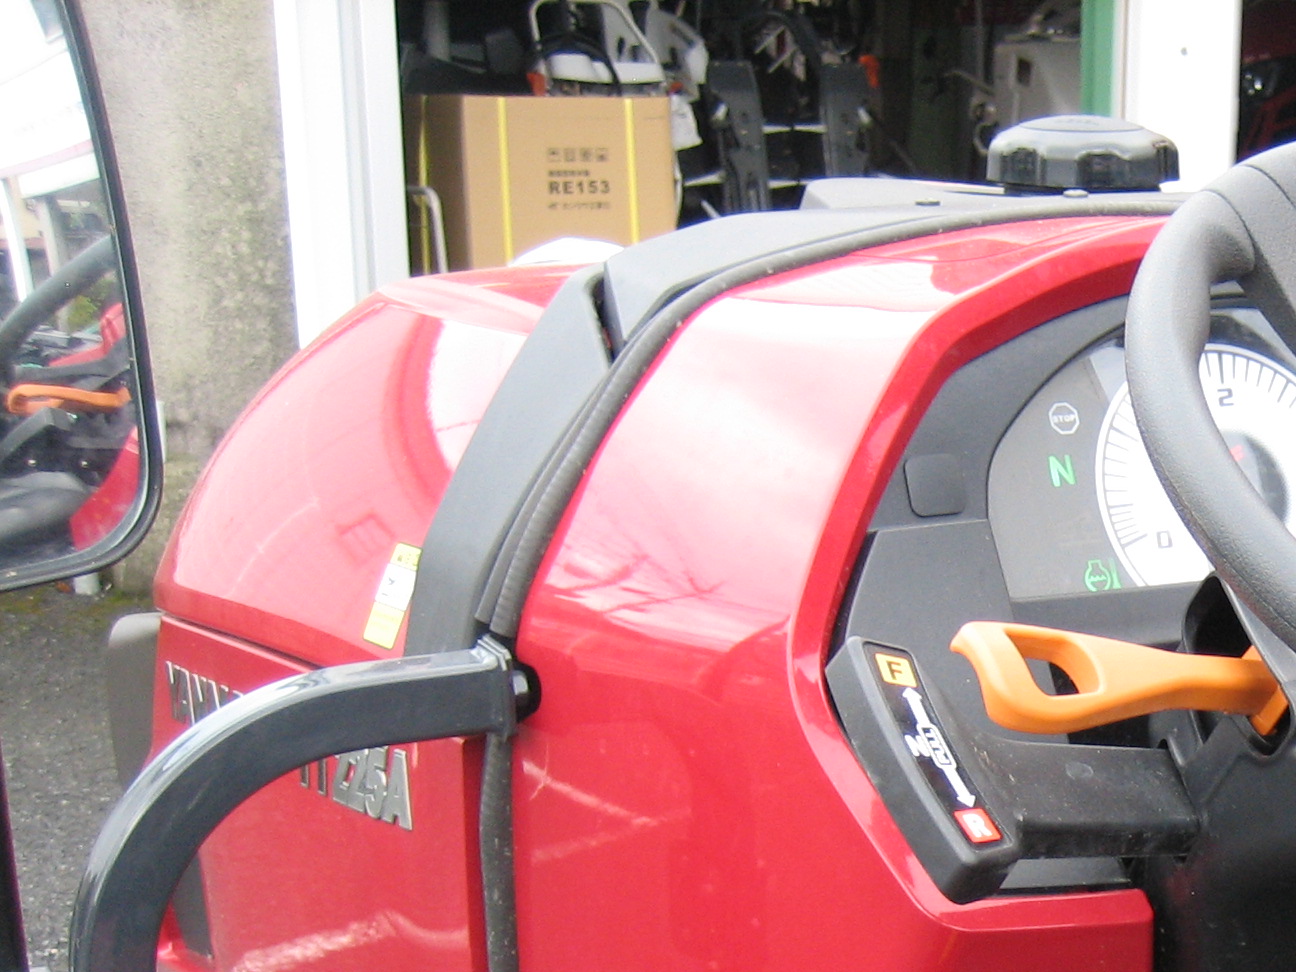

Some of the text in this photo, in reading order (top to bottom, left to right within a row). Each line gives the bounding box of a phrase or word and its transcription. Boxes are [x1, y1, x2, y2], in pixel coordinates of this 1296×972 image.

[548, 180, 610, 194] RE153
[1217, 388, 1234, 407] 2
[1048, 455, 1075, 487] N
[1157, 531, 1172, 548] 0
[887, 660, 902, 680] F
[904, 734, 931, 757] N
[962, 813, 992, 838] R
